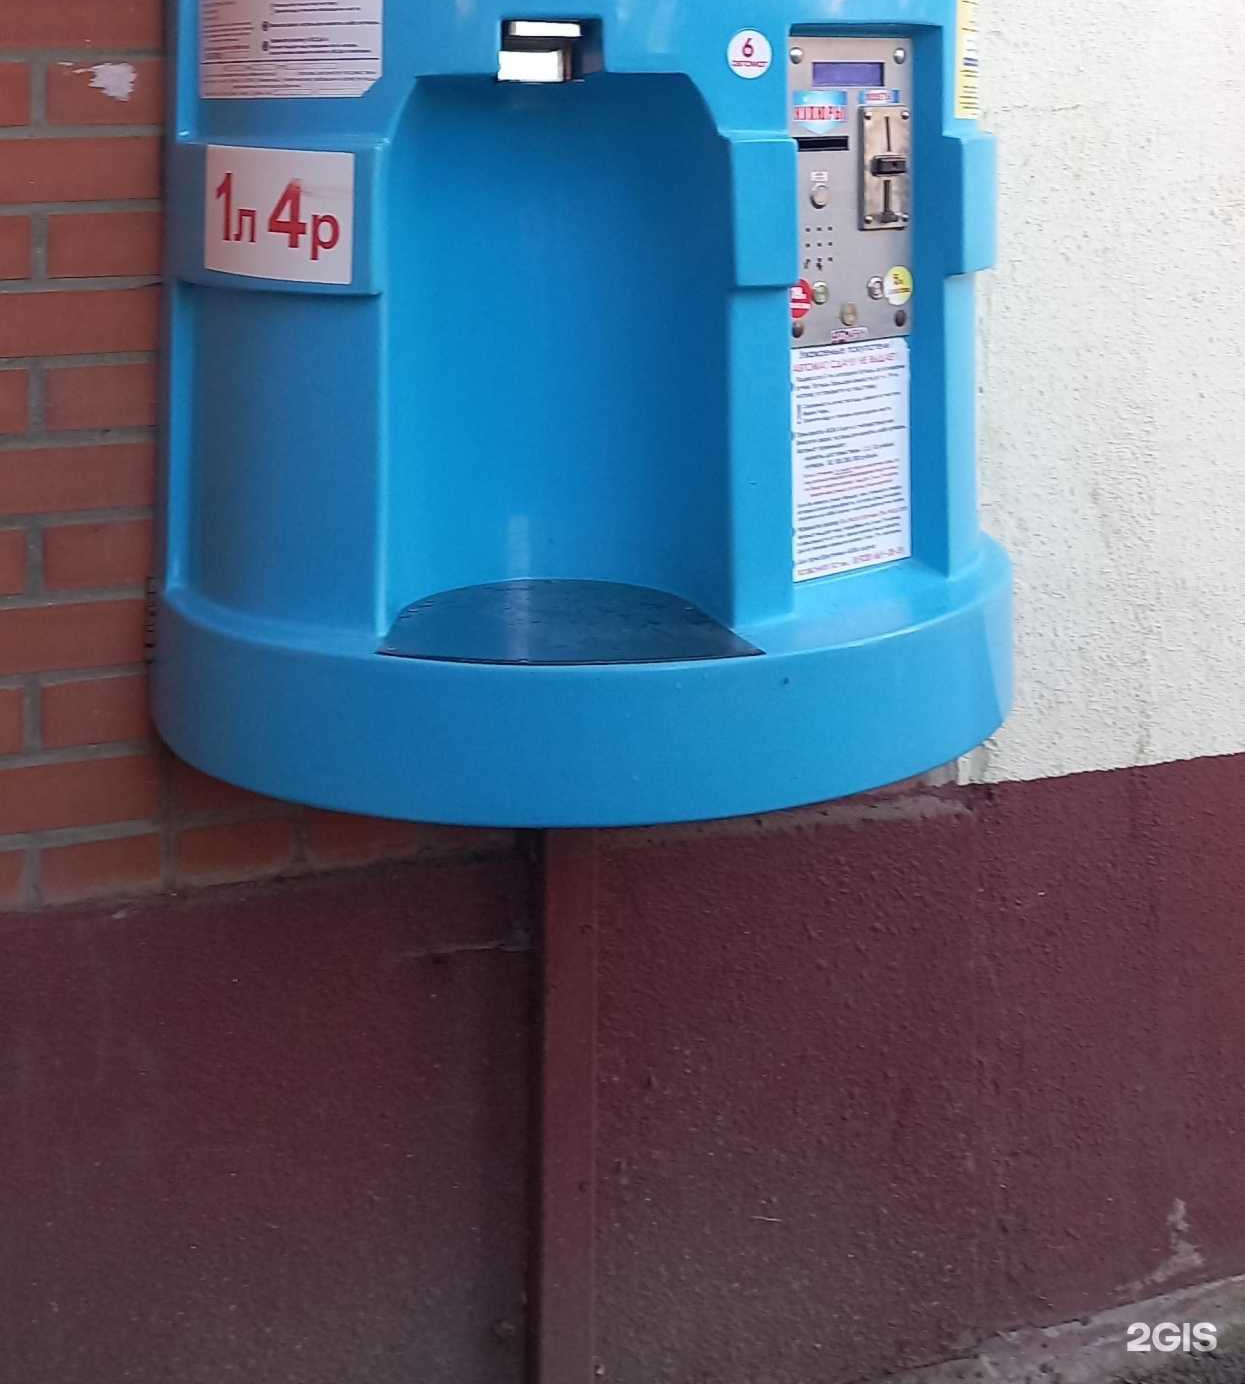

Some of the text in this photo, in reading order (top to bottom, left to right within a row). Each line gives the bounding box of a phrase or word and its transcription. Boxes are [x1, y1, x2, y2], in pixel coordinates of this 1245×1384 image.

[742, 37, 755, 58] 6
[215, 172, 341, 261] 1л 4р
